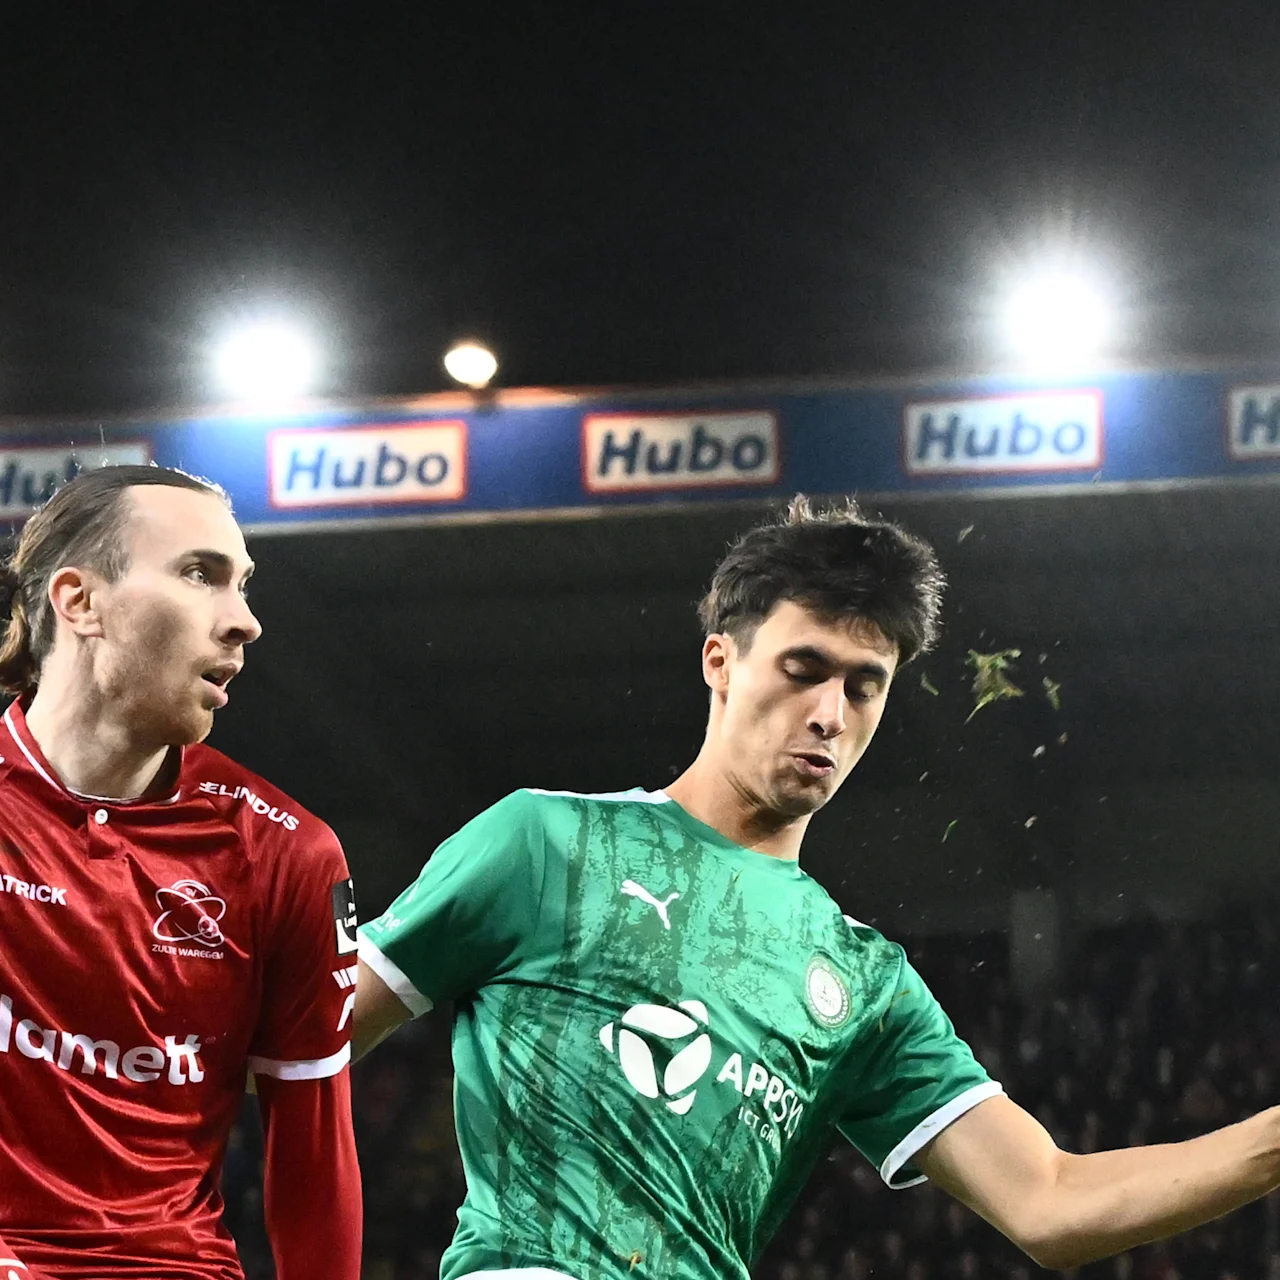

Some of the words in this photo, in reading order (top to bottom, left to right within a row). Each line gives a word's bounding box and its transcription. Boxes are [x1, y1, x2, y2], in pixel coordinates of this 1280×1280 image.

[598, 427, 766, 479] Hubo
[916, 405, 1086, 461] Hubo
[283, 437, 451, 490] Hubo
[199, 781, 300, 831] ELINDUS
[152, 943, 177, 955] ZULTE
[738, 1106, 760, 1129] ICT
